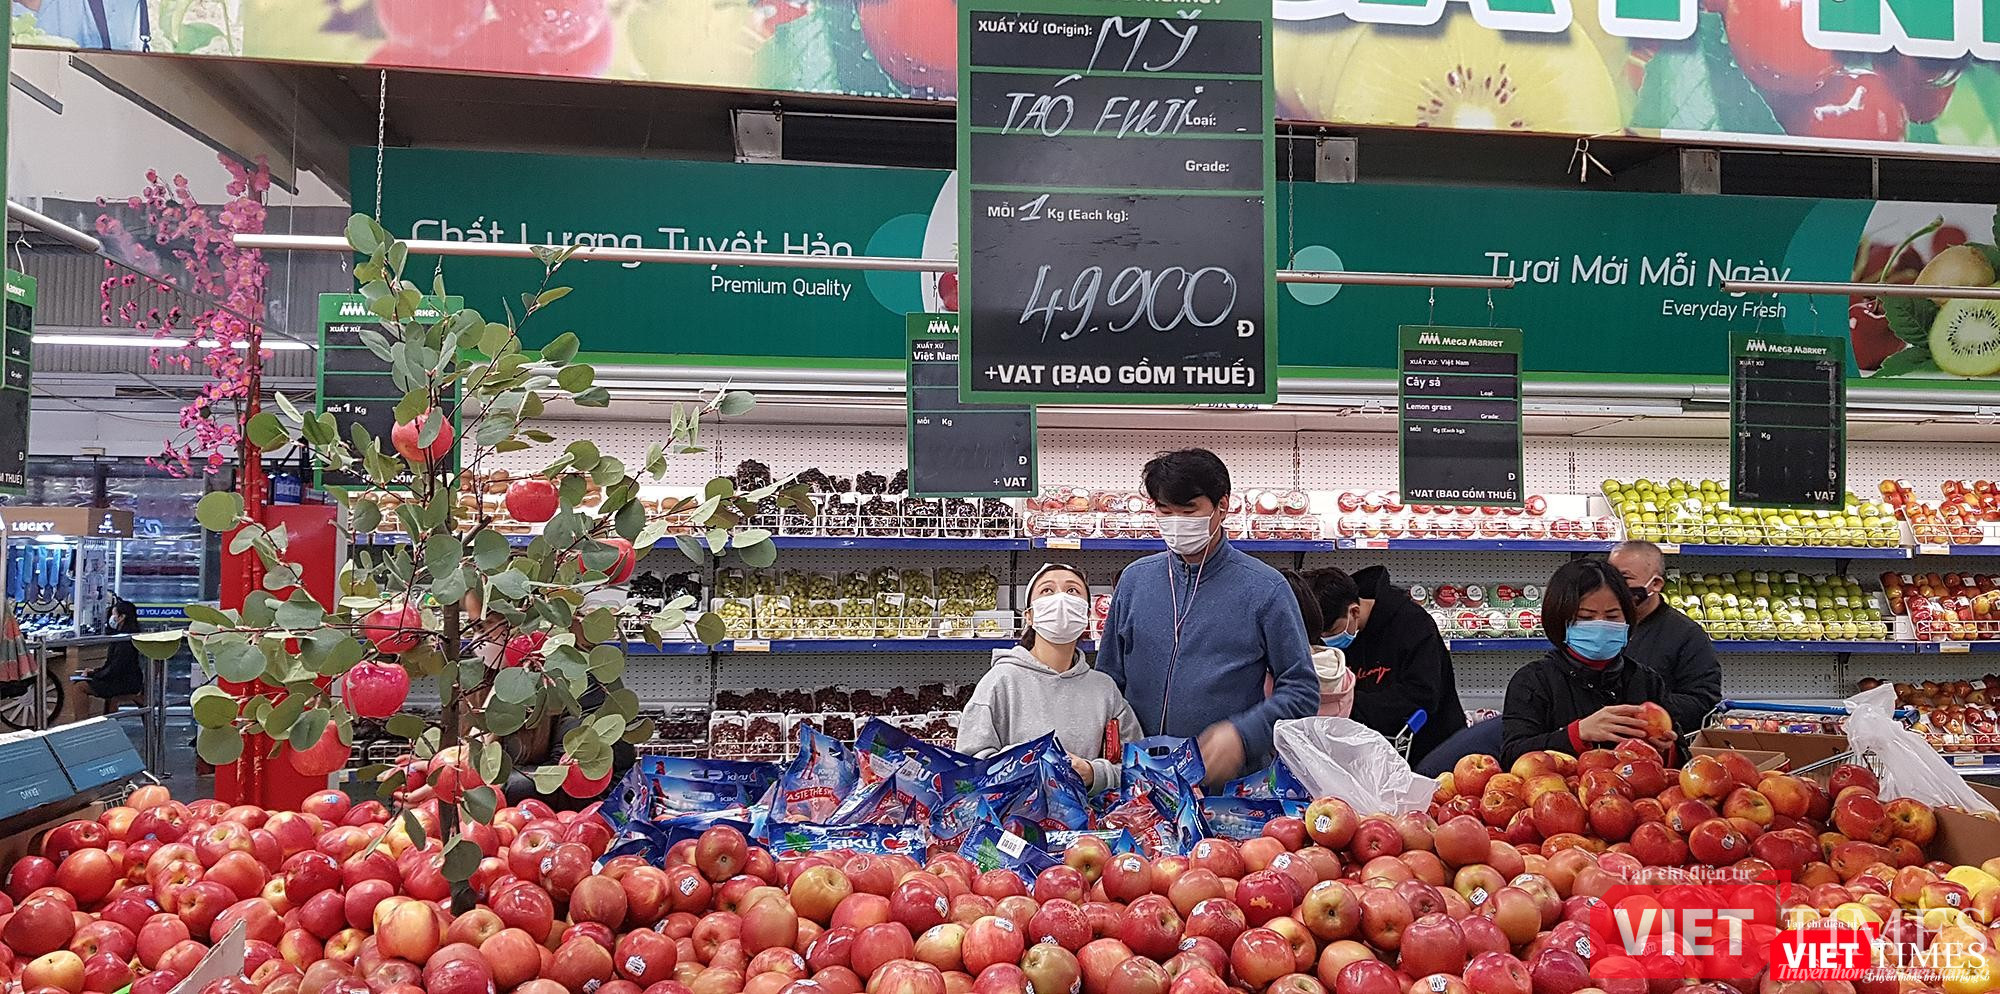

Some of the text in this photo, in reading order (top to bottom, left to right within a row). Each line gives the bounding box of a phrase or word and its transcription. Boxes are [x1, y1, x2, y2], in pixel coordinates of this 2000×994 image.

[978, 17, 1093, 38] XUẤT XỨ (Origin):
[1185, 159, 1230, 172] Grade:
[987, 194, 1129, 222] MỖI 1 Kg (Each kg):
[1571, 254, 1628, 285] Mới
[1639, 252, 1697, 287] Mỗi
[711, 275, 851, 301] Premium Quality
[1662, 300, 1787, 321] Everyday Fresh
[1236, 320, 1255, 337] Đ
[913, 351, 959, 361] Việt Nam
[984, 357, 1255, 387] +VAT (BAO GỒM THUẾ)
[354, 406, 367, 415] Kg
[942, 418, 953, 427] Kg
[1761, 432, 1771, 440] Kg
[1003, 477, 1027, 487] VAT
[1436, 489, 1460, 499] (BAO
[1813, 491, 1836, 501] VAT
[12, 522, 54, 531] LUCKY
[827, 839, 877, 850] KIKU
